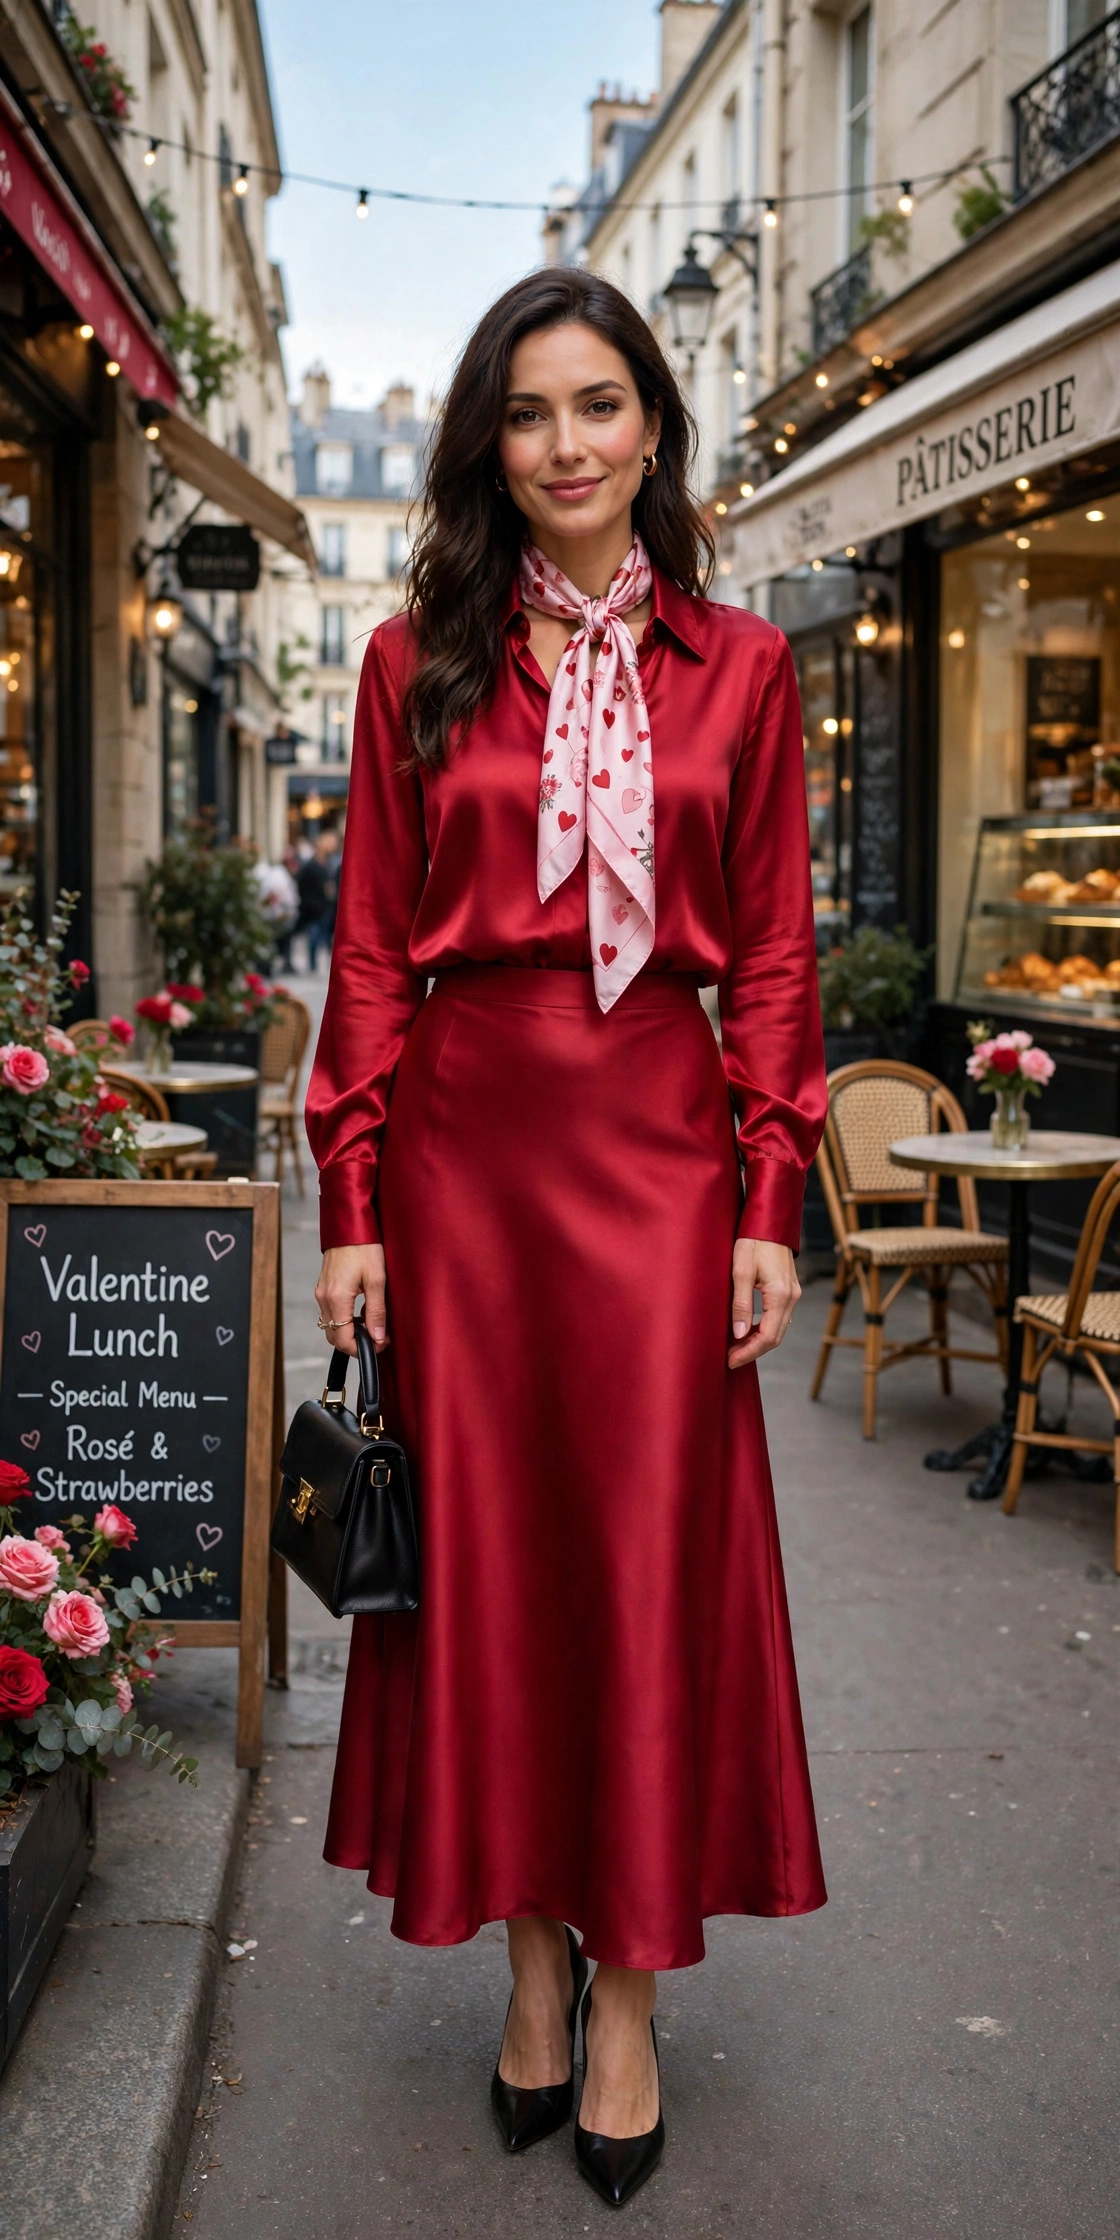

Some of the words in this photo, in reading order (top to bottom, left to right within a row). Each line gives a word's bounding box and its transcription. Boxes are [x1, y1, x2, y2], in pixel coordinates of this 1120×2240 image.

[896, 375, 1077, 507] PÂTISSERIE
[40, 1254, 211, 1303] Valentine
[67, 1312, 179, 1358] Lunch
[49, 1380, 129, 1416] Special
[138, 1380, 197, 1409] Menu
[66, 1424, 135, 1461] Rosé
[150, 1431, 168, 1460] &
[35, 1467, 214, 1503] Strawberries
